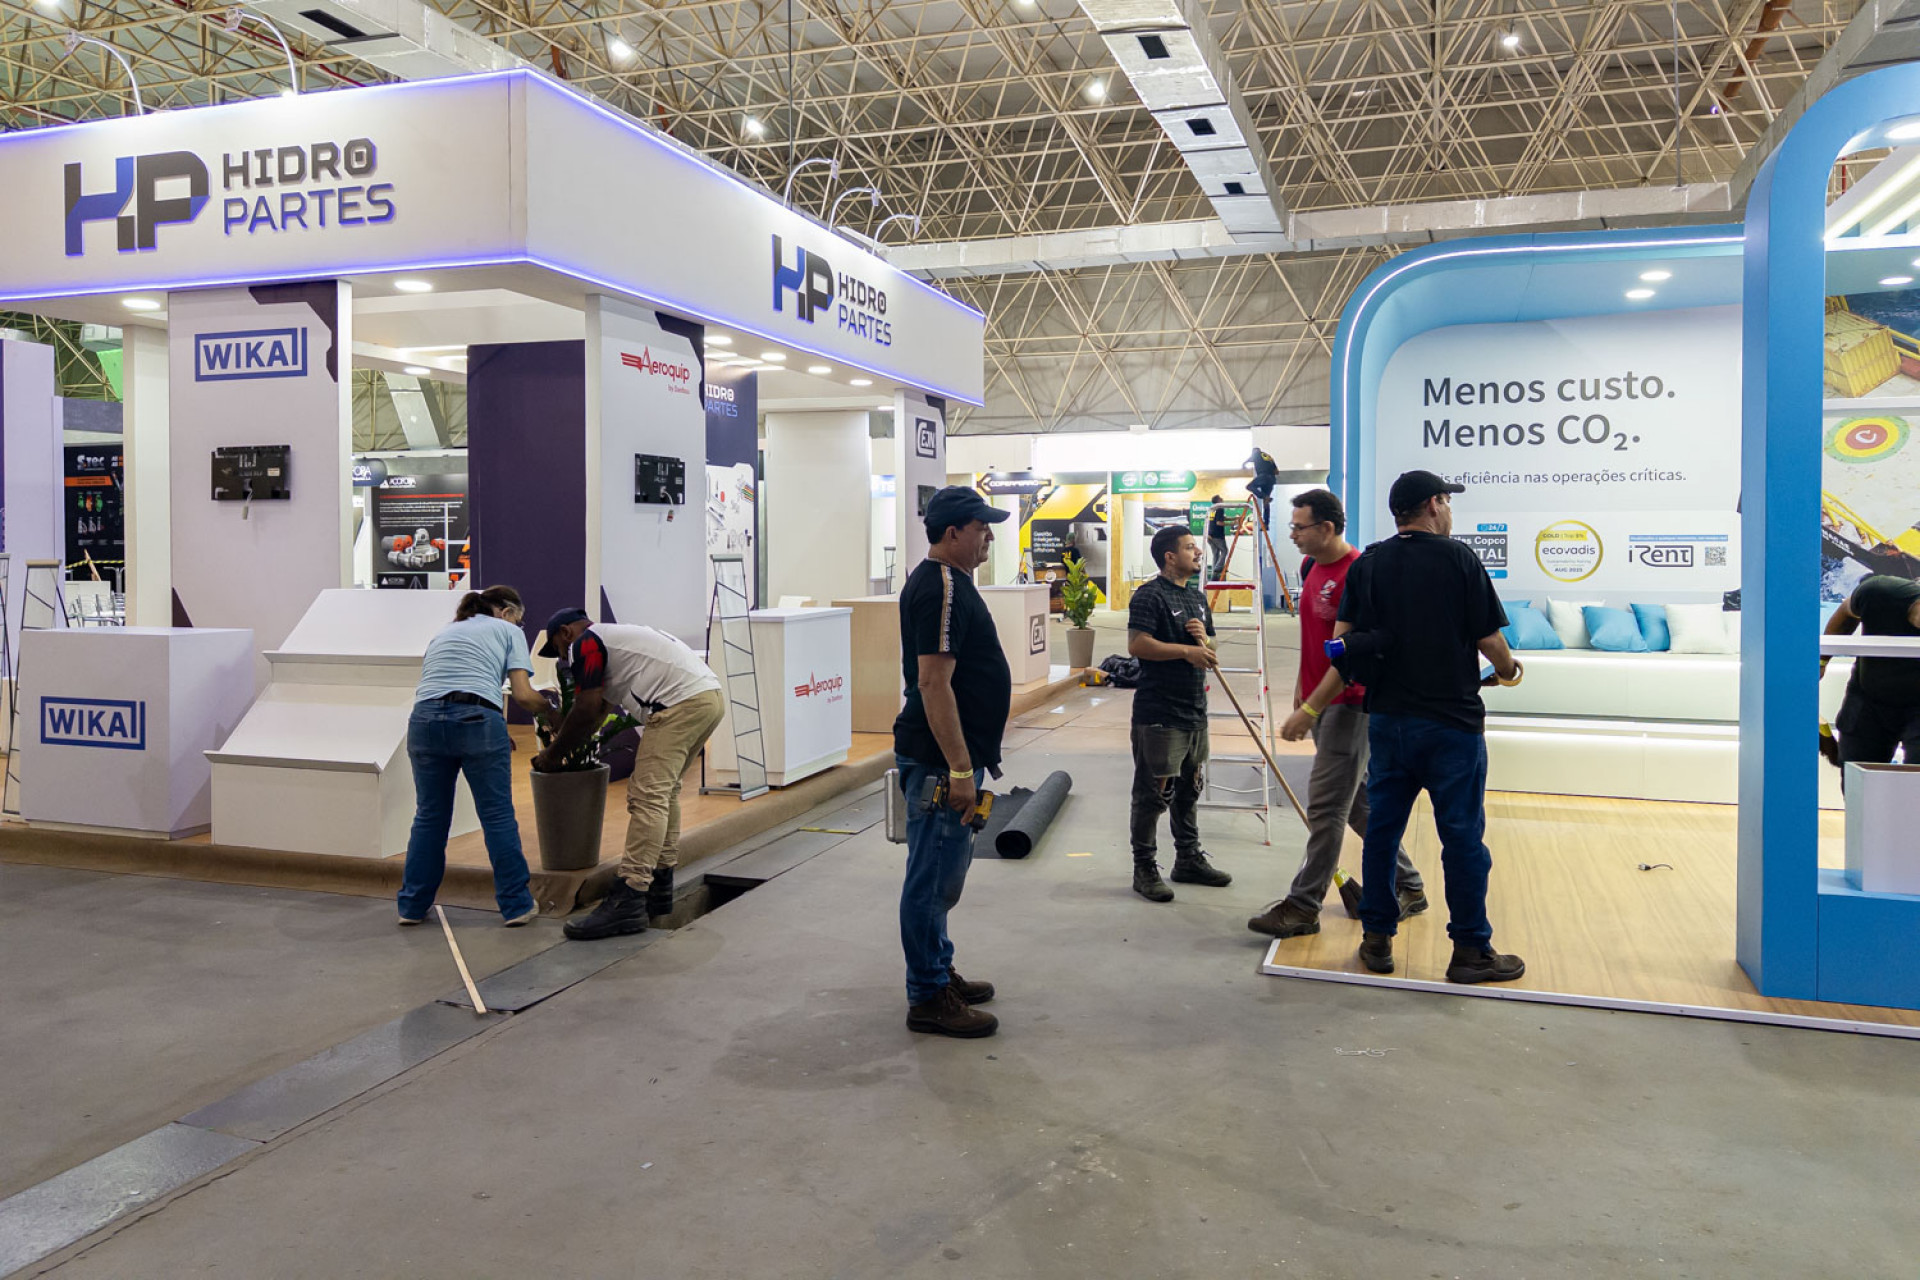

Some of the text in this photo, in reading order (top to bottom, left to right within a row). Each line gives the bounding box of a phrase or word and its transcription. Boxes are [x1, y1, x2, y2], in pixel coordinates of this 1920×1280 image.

[223, 138, 377, 188] HIDRO
[224, 183, 395, 235] PARTES
[839, 271, 887, 315] HIDRO
[839, 303, 892, 347] PARTES
[203, 340, 289, 371] WIKA
[621, 346, 690, 384] Aeroquip
[1423, 371, 1676, 406] Menos custo.
[1423, 419, 1546, 448] Menos
[1454, 471, 1519, 485] eficiência
[1524, 473, 1549, 483] nas
[1552, 469, 1626, 485] operações
[1630, 467, 1687, 481] críticas.
[1475, 536, 1506, 546] Copco
[1542, 544, 1596, 555] ecovadis
[48, 708, 129, 738] WIKA
